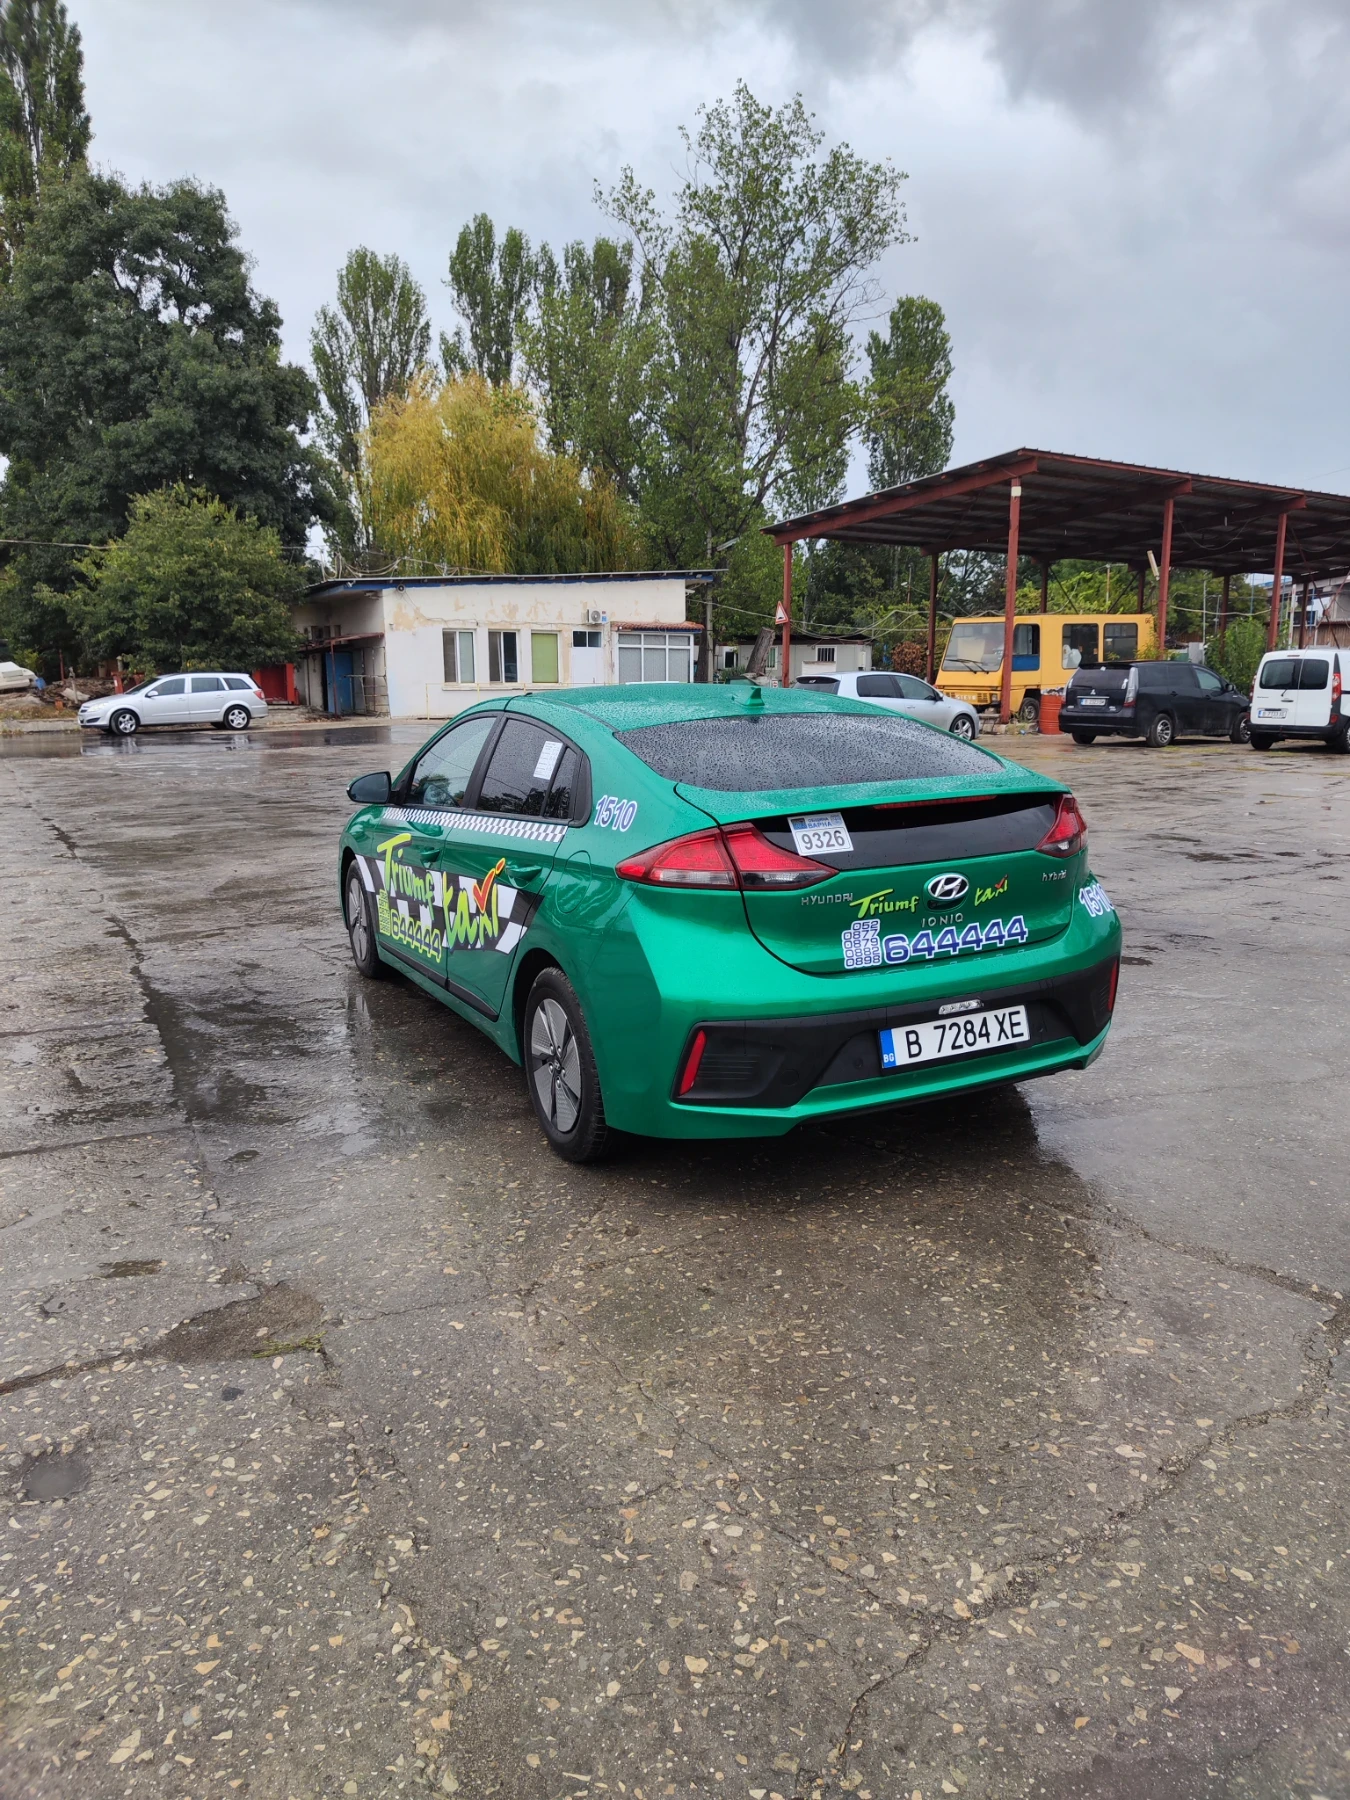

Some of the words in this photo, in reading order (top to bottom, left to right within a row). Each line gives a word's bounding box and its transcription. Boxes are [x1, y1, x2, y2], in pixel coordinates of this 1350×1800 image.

[594, 795, 637, 832] 1510
[801, 830, 845, 850] 9326
[377, 833, 434, 921] Triumf
[442, 857, 506, 950] taxi
[849, 888, 919, 919] Triumf
[974, 874, 1008, 906] taxi
[801, 893, 853, 906] HYUNDAI
[852, 920, 879, 931] 052
[921, 913, 964, 928] IONIQ
[391, 909, 441, 963] 644444
[843, 929, 878, 941] 0877
[884, 916, 1028, 963] 644444
[844, 938, 879, 950] 0879
[845, 947, 880, 959] 0882
[846, 956, 881, 967] 0898
[905, 1030, 922, 1058] B
[933, 1016, 991, 1053] 7284
[994, 1010, 1024, 1041] XE
[883, 1053, 895, 1063] BG
